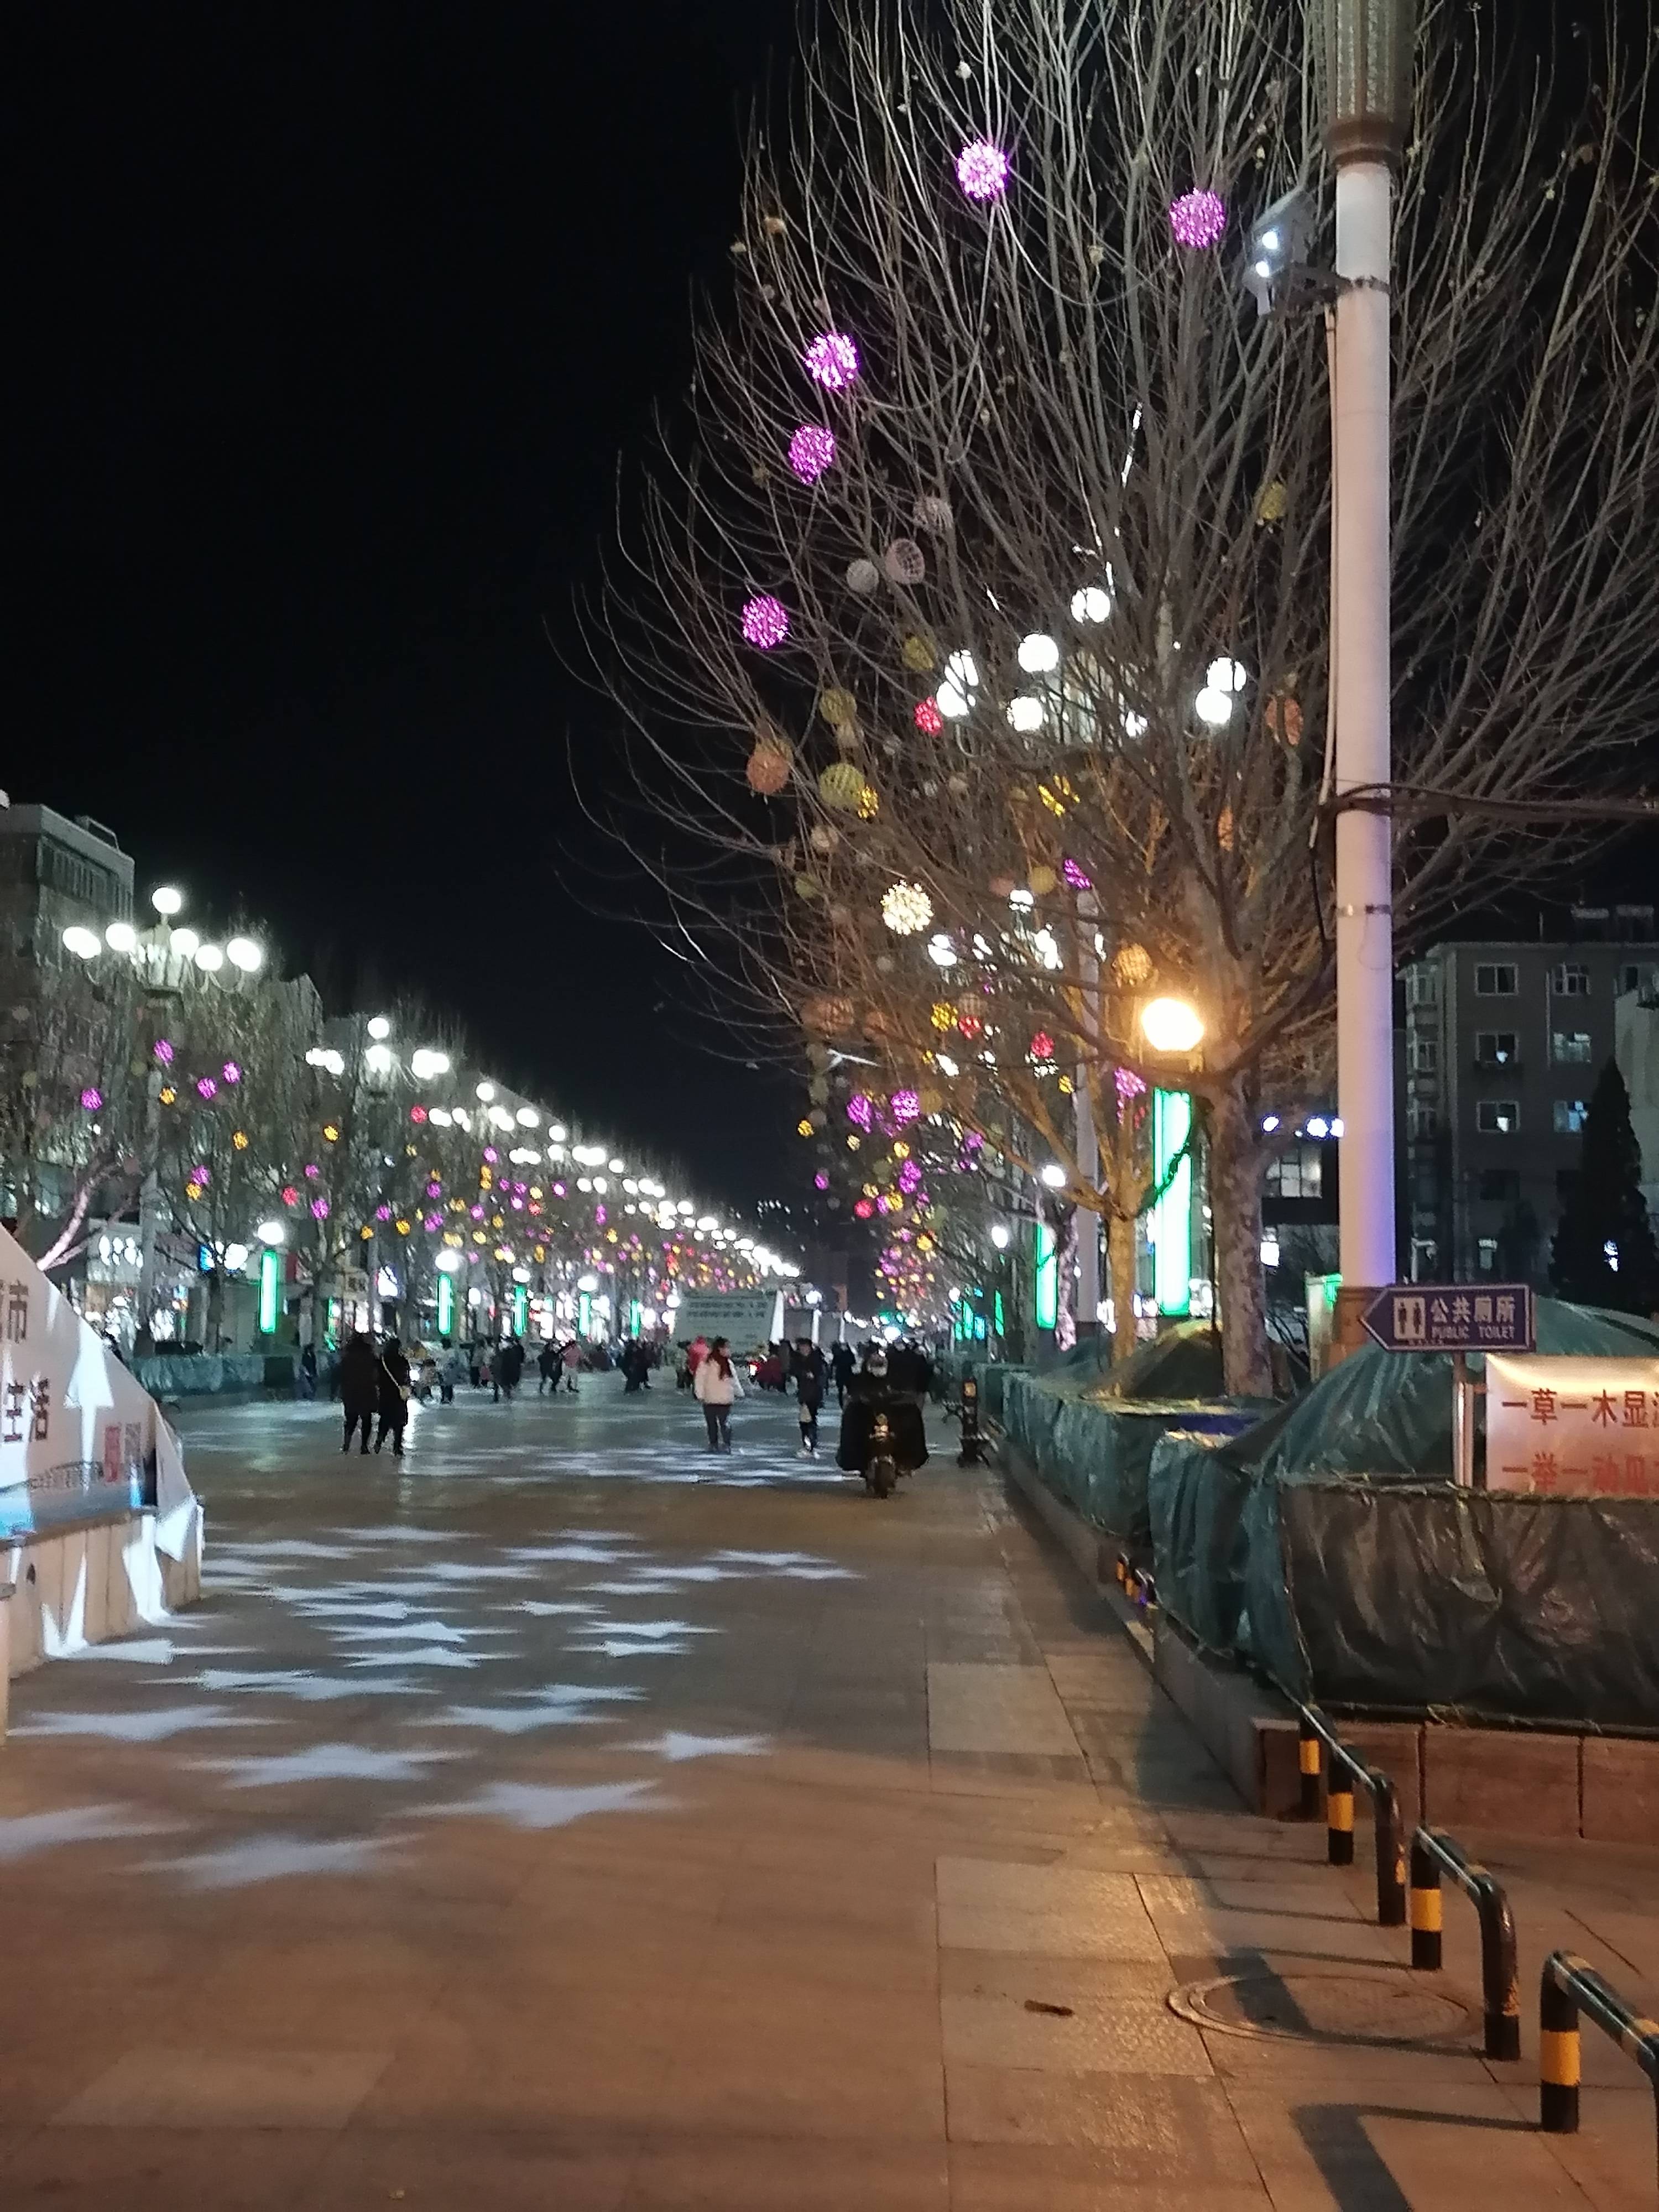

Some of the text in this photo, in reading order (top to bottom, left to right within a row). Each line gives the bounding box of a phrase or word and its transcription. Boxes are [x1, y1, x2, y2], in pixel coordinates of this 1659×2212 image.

[0, 1279, 29, 1344] 市
[1431, 1326, 1515, 1339] PUBLIC TOILET
[1502, 1388, 1659, 1428] 一草一木显
[1502, 1451, 1659, 1495] 一举一动见
